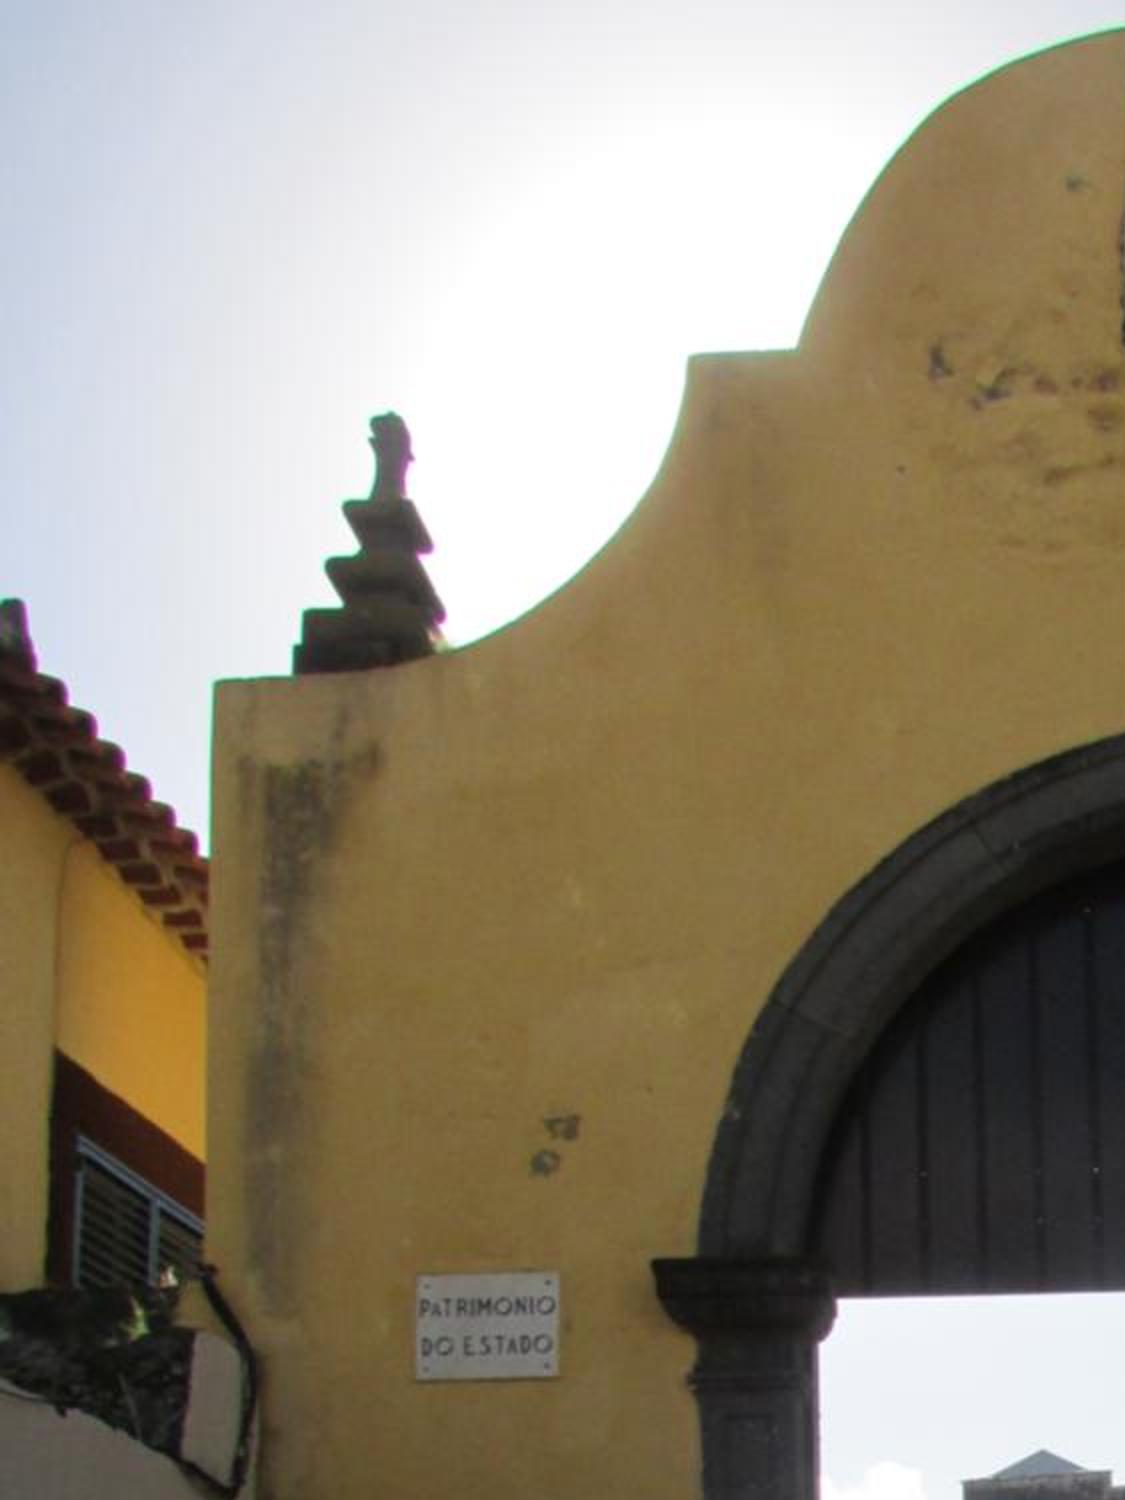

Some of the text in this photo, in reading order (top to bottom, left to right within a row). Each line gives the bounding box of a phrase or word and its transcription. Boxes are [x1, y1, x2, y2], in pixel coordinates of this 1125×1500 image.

[418, 1295, 557, 1318] PATRIMONIO
[420, 1333, 554, 1357] DO ESTADO
